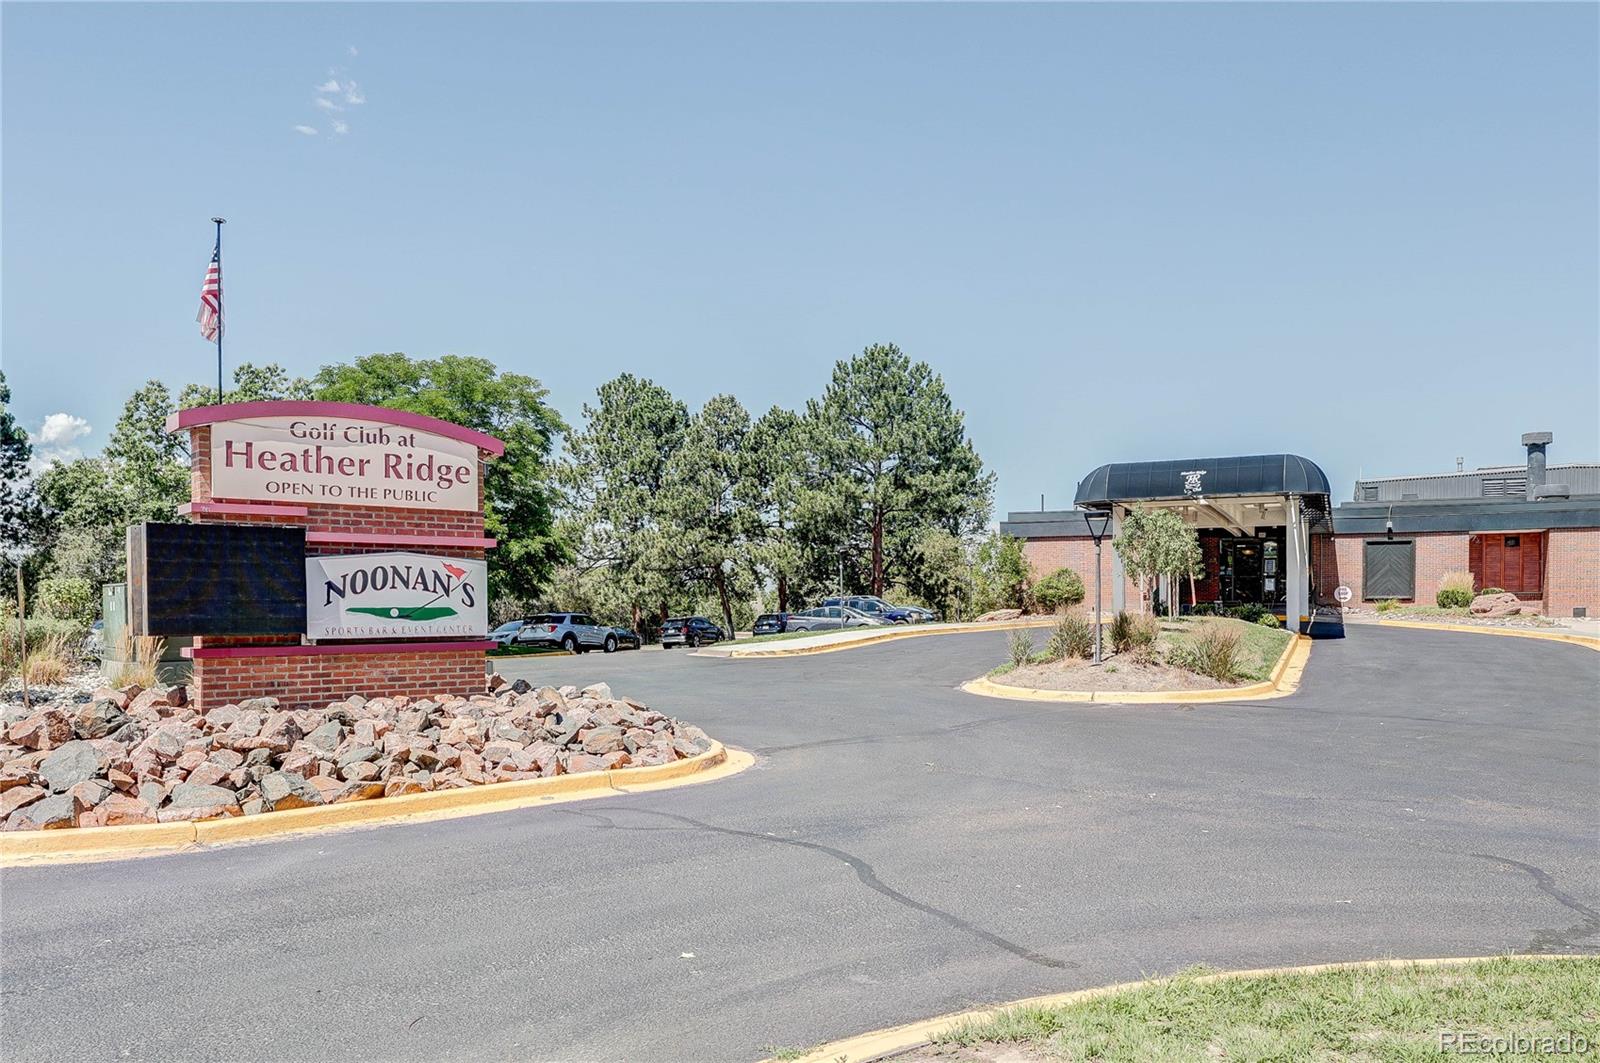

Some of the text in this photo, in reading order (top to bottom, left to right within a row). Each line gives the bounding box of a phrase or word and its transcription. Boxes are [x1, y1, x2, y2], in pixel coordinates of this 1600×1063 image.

[290, 421, 415, 448] Golf Club at
[225, 440, 471, 490] Heather Ridge
[265, 481, 438, 503] OPEN TO THE PUBLIC
[324, 626, 365, 636] SPORTS
[368, 625, 388, 636] BAR
[401, 625, 433, 635] EVENT
